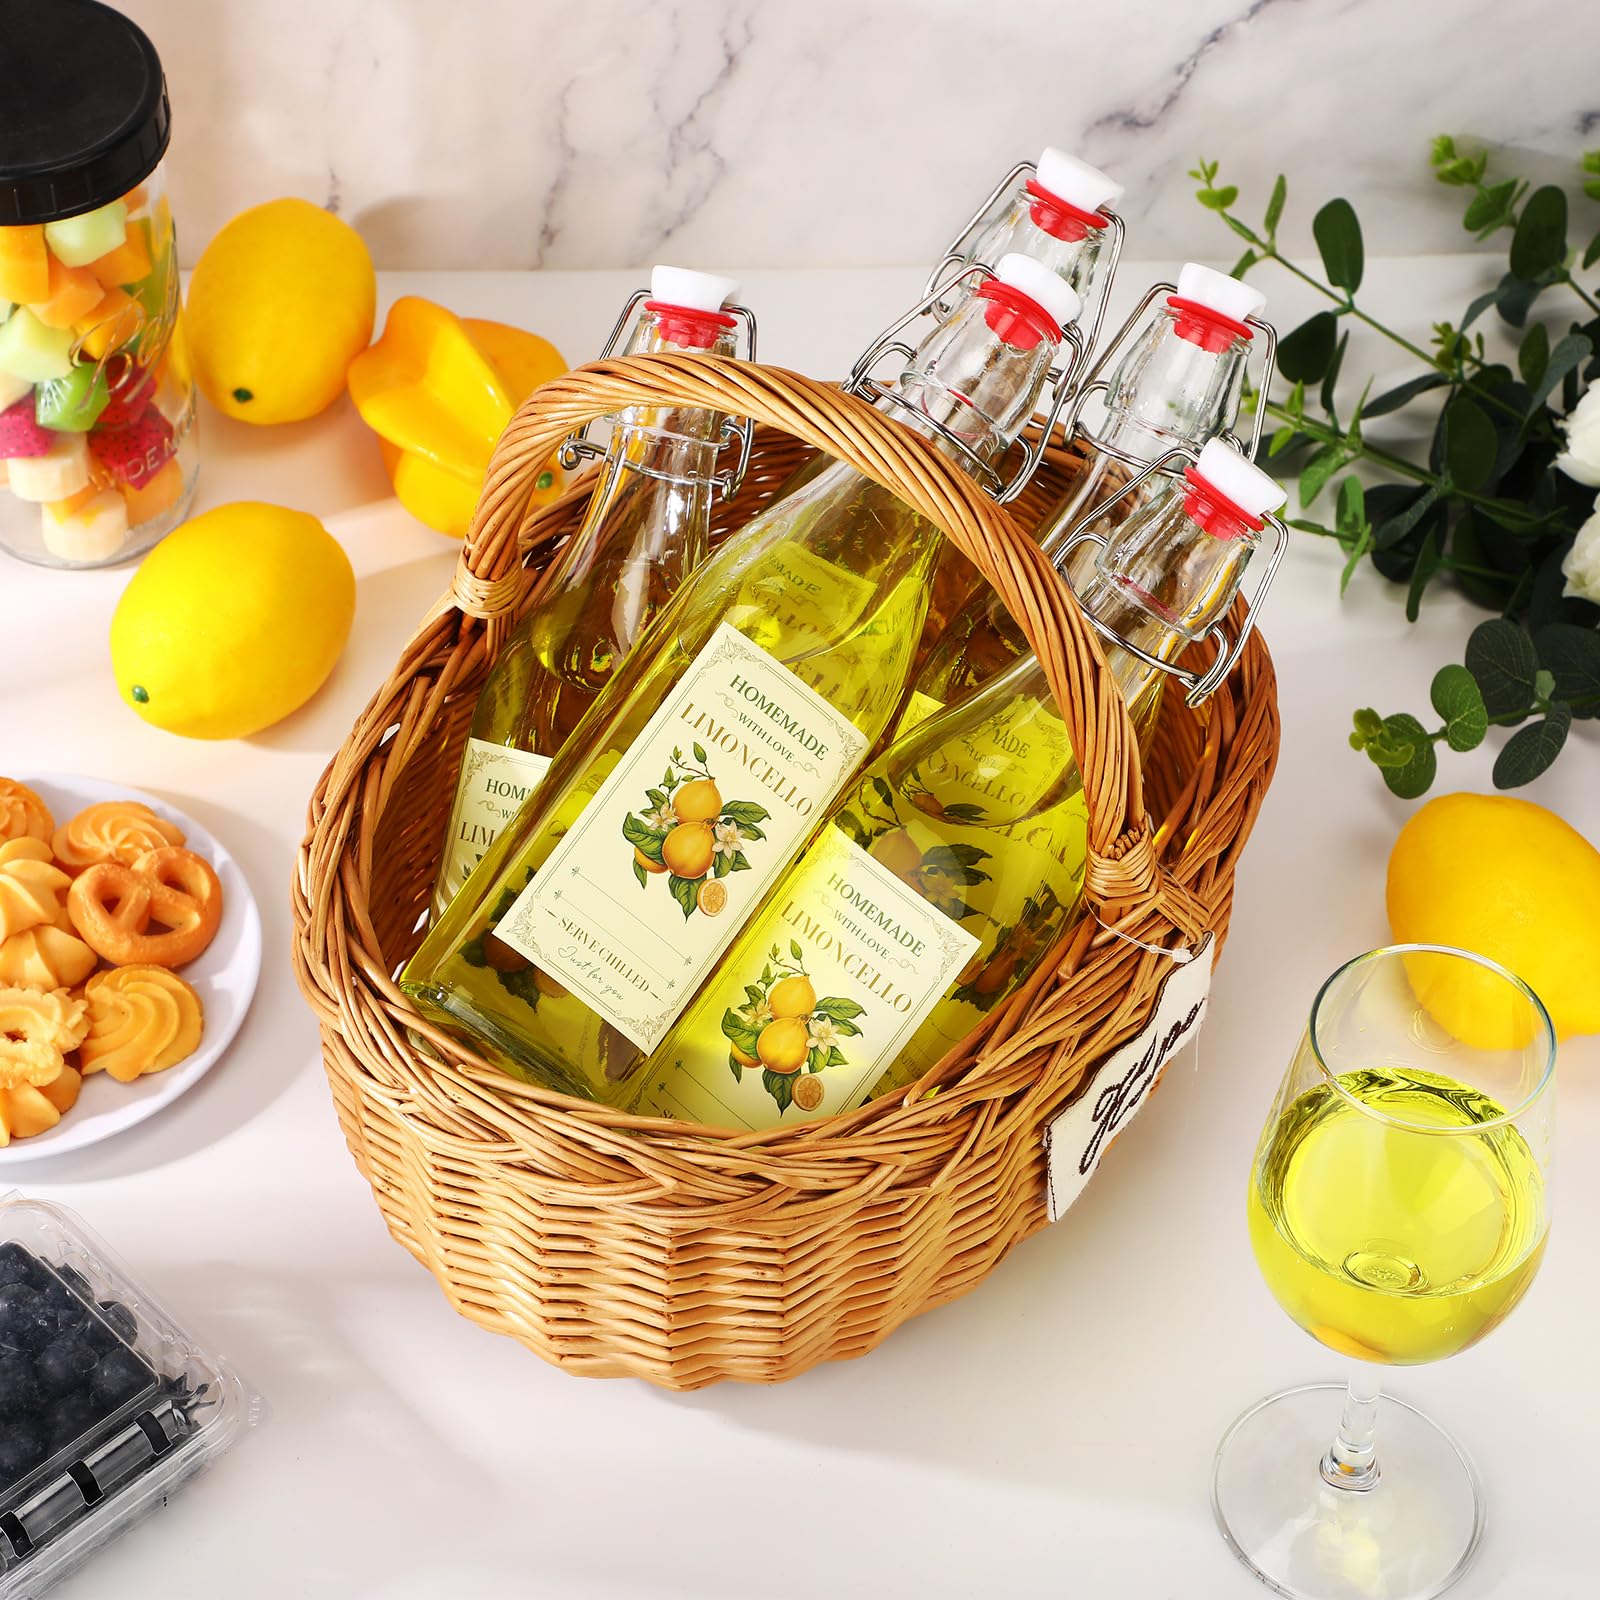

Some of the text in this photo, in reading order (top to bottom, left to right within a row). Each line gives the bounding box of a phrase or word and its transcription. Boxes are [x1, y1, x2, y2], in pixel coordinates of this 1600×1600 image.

[729, 674, 829, 761] HOMEMADE
[738, 712, 795, 763] WITH LOVE
[680, 702, 814, 817] LIMONCELLO
[558, 916, 650, 993] SERVE CHILLED
[826, 872, 927, 958] HOMEMADE
[833, 909, 890, 960] WITH LOVE
[558, 945, 625, 1001] Just for you
[780, 900, 913, 1013] LIMONCELLO
